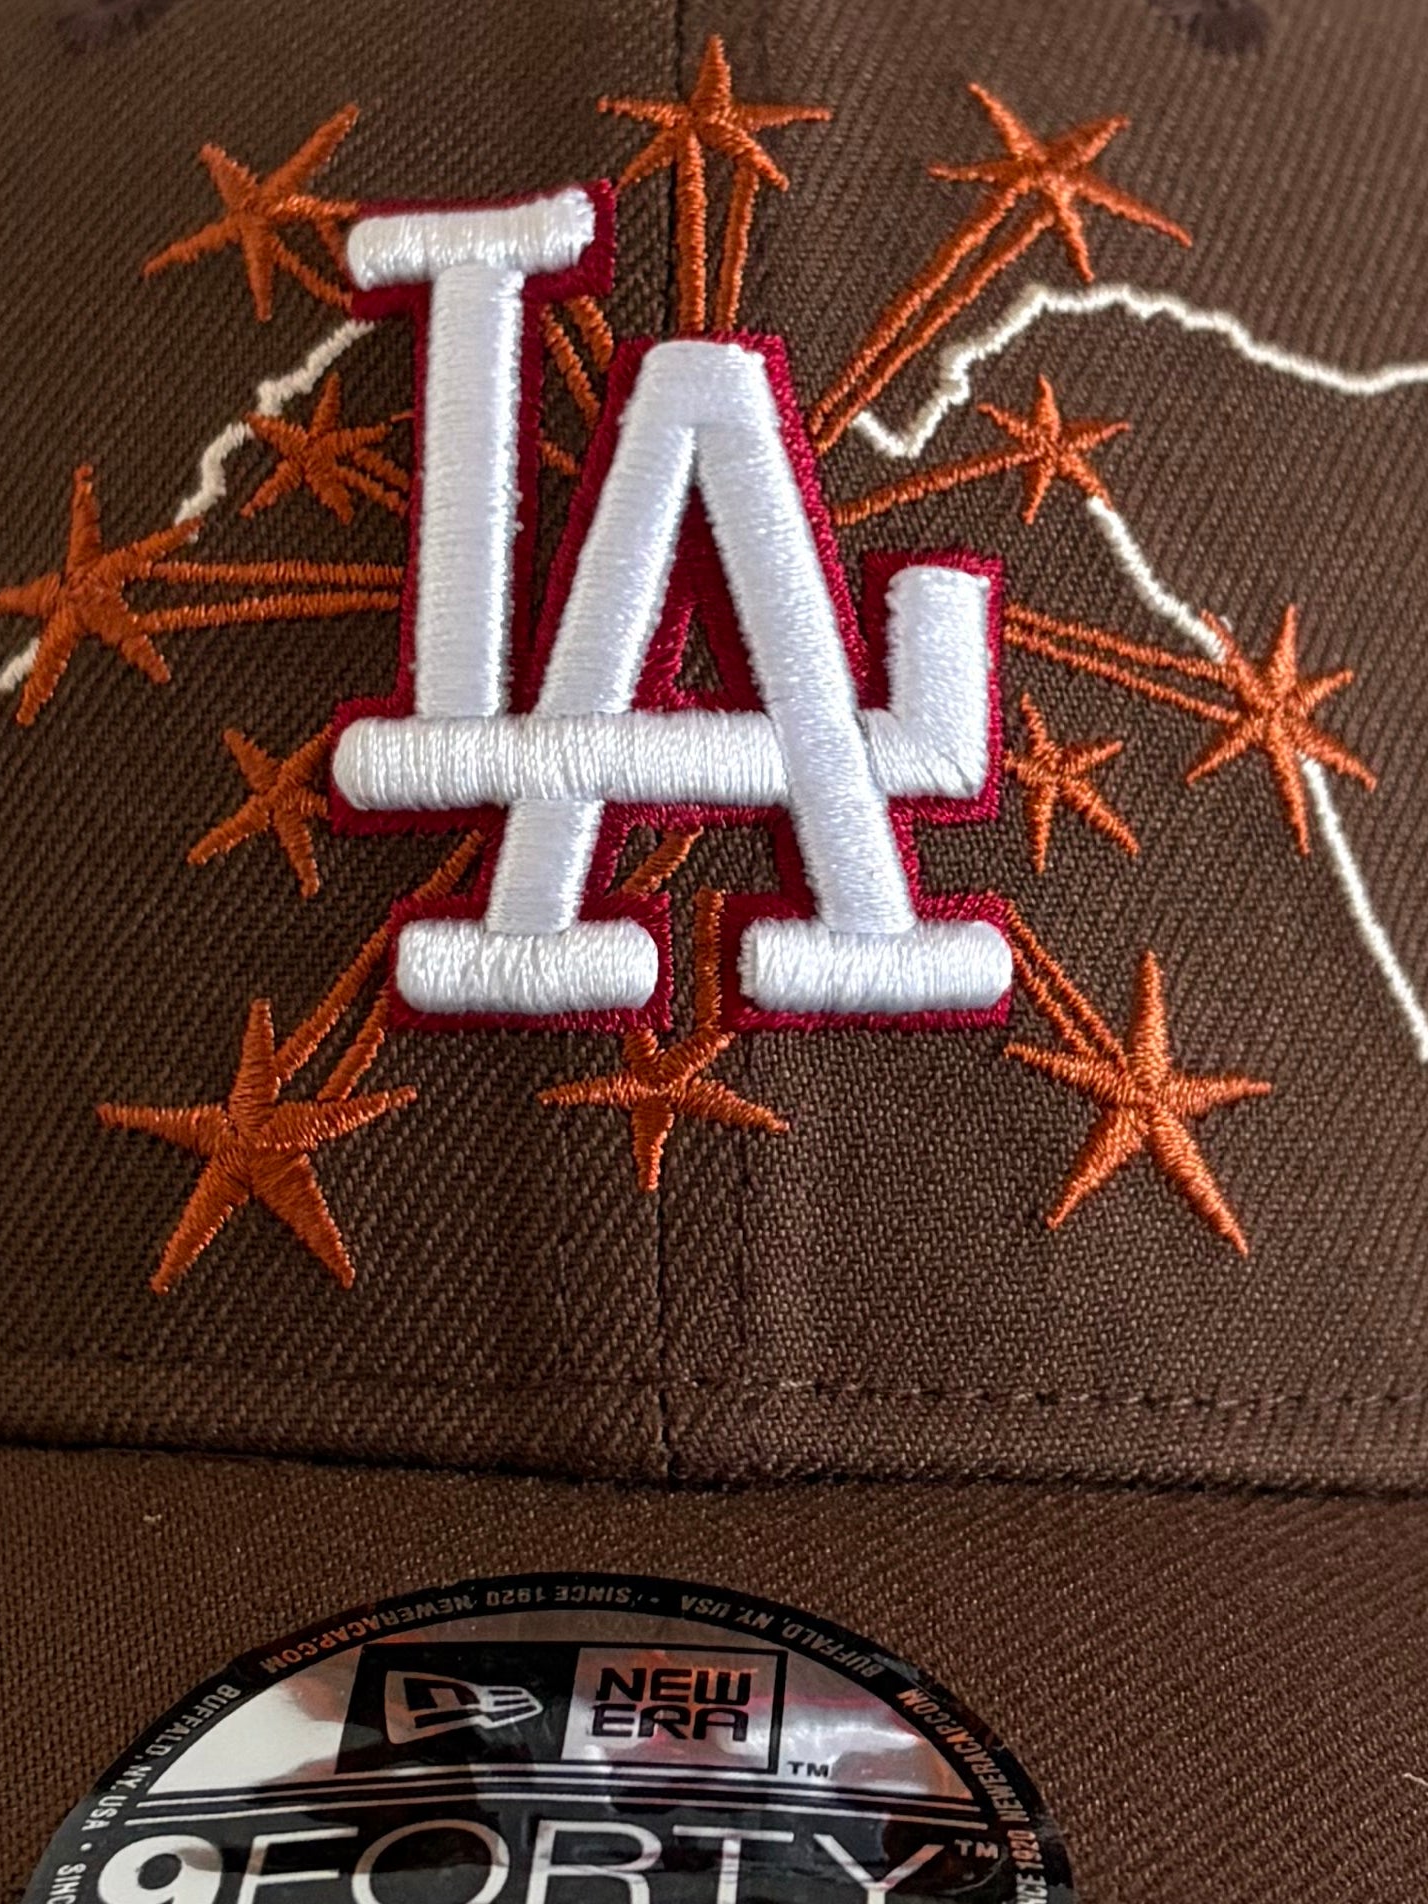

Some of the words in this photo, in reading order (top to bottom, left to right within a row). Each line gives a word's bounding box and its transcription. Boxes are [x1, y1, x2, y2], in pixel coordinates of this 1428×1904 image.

[331, 182, 1014, 1016] LA
[486, 1589, 546, 1607] 1920
[554, 1584, 633, 1604] SINCE
[680, 1594, 731, 1619] USA
[594, 1666, 753, 1707] NEW
[591, 1702, 750, 1743] ERA
[80, 1794, 128, 1832] USA
[1006, 1829, 1045, 1870] 1920
